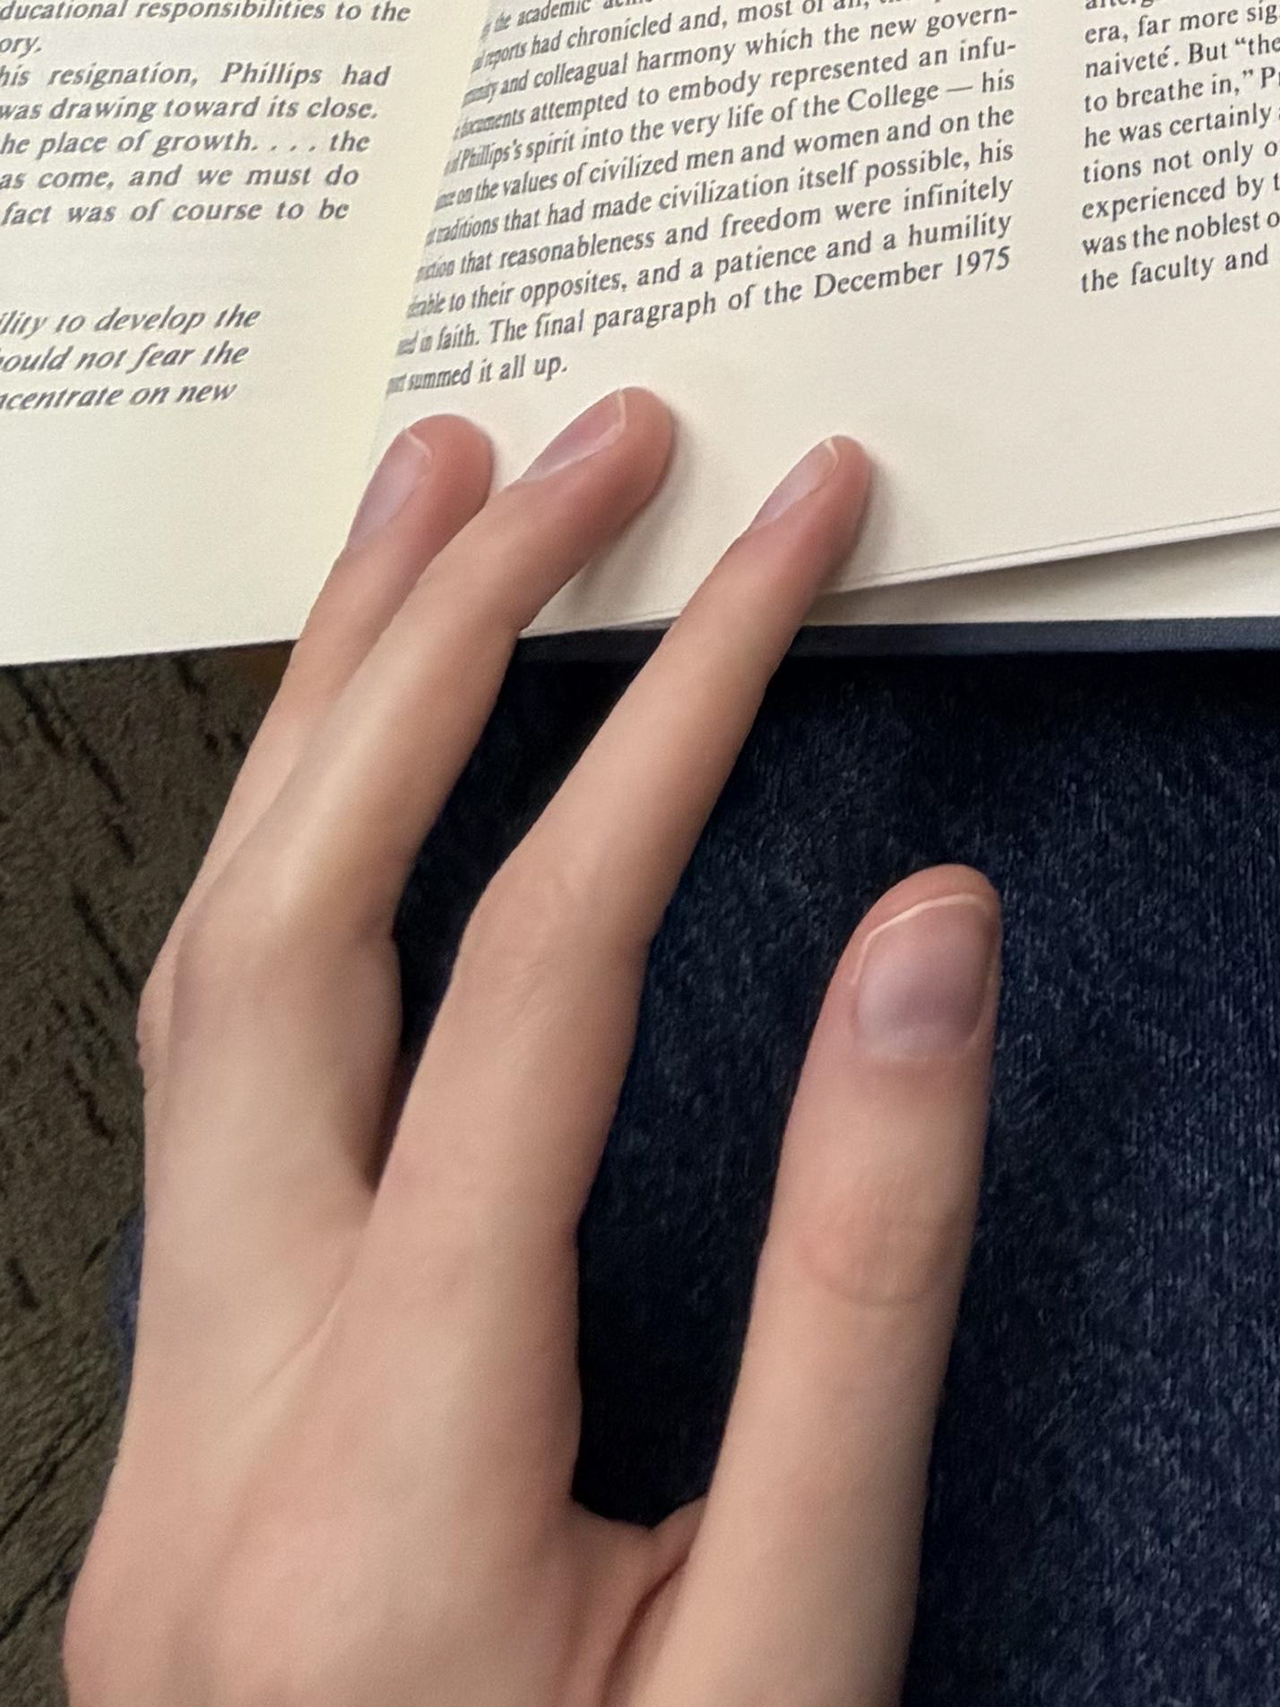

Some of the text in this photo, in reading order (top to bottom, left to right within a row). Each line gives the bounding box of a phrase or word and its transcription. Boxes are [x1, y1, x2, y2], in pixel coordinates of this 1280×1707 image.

[0, 197, 350, 227] fact was of course to be
[534, 245, 1011, 339] final paragraph of the December 1975
